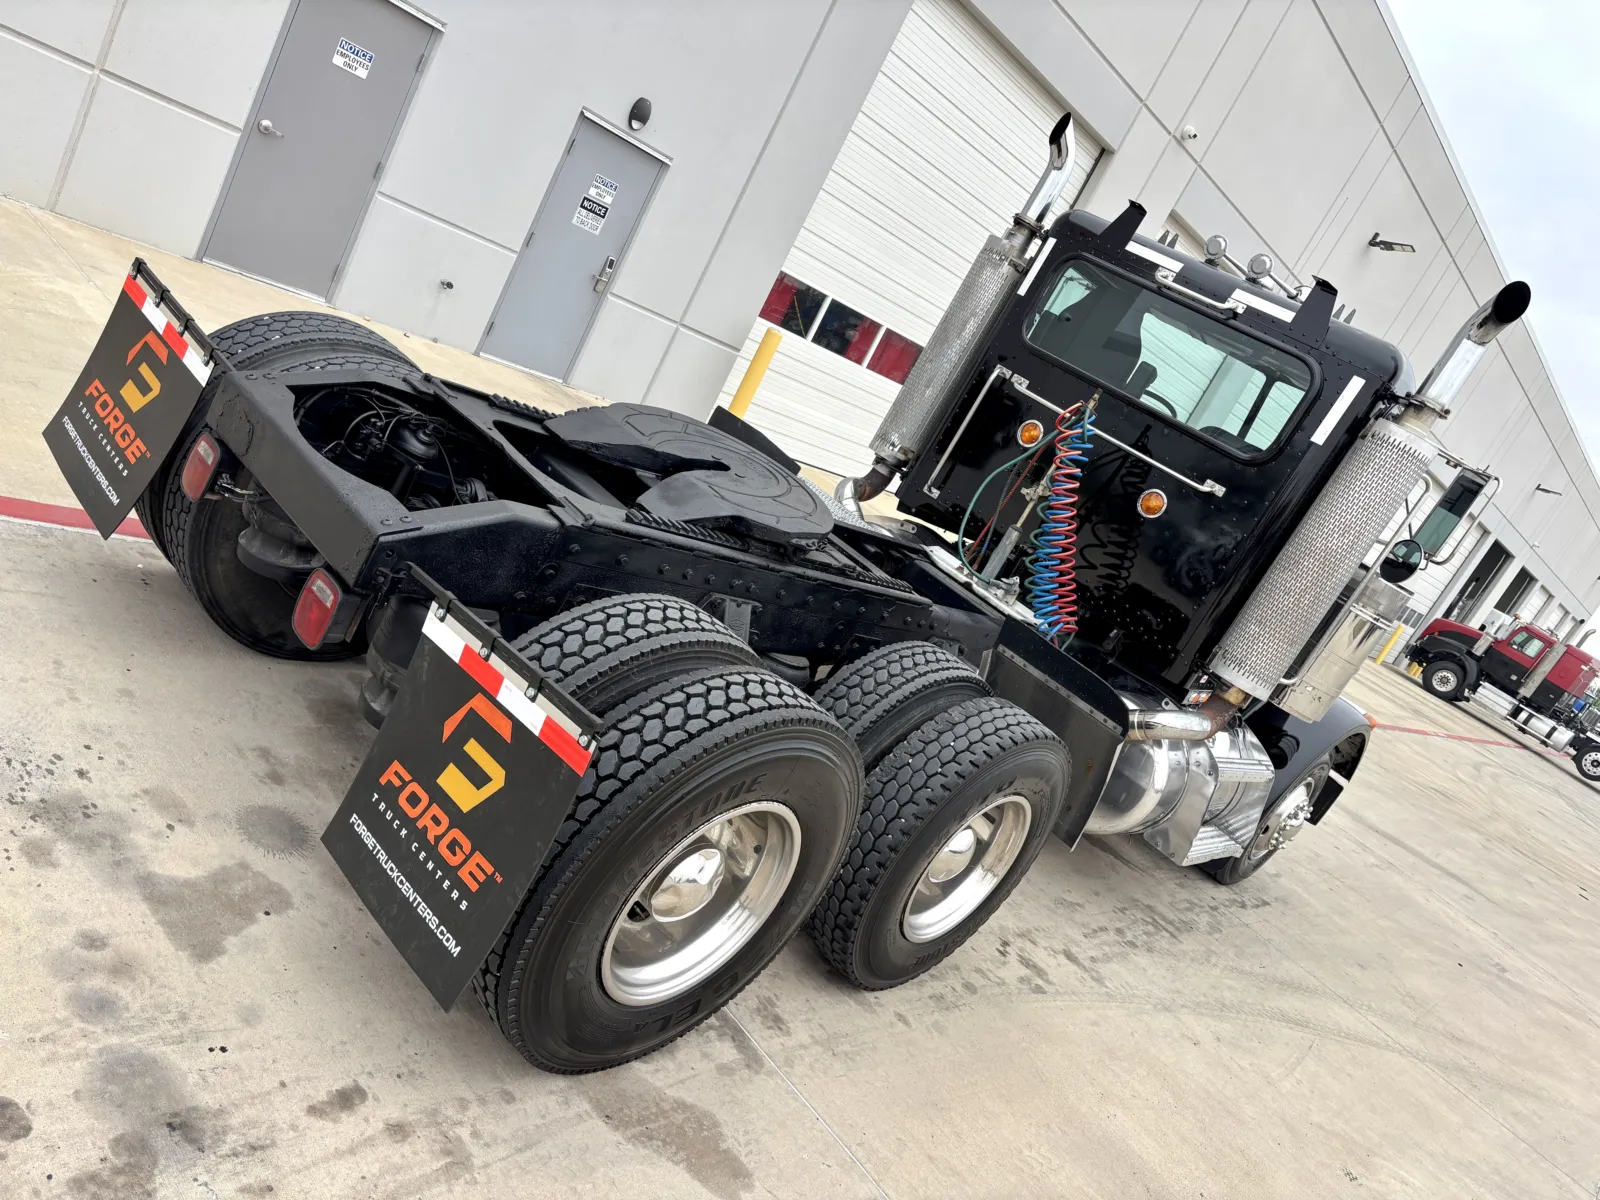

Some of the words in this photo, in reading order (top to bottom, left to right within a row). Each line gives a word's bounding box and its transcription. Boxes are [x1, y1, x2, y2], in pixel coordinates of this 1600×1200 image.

[336, 49, 370, 71] EMPLOYEES
[340, 40, 372, 62] NOTICE
[343, 60, 358, 72] ONLY
[591, 183, 614, 198] EMPLOYEES
[594, 175, 618, 192] NOTICE
[595, 190, 606, 199] ONLY
[582, 199, 607, 216] NOTICE
[84, 378, 147, 465] FORGE
[78, 400, 98, 432] TRUCK
[98, 433, 128, 477] CENTERS
[61, 415, 121, 506] FORGETRUCKCENTERS.COM
[378, 759, 495, 893] FORGE
[371, 792, 409, 839] TRUCK
[411, 841, 469, 911] CENTERS
[349, 812, 462, 958] FORGETRUCKCENTERS.COM
